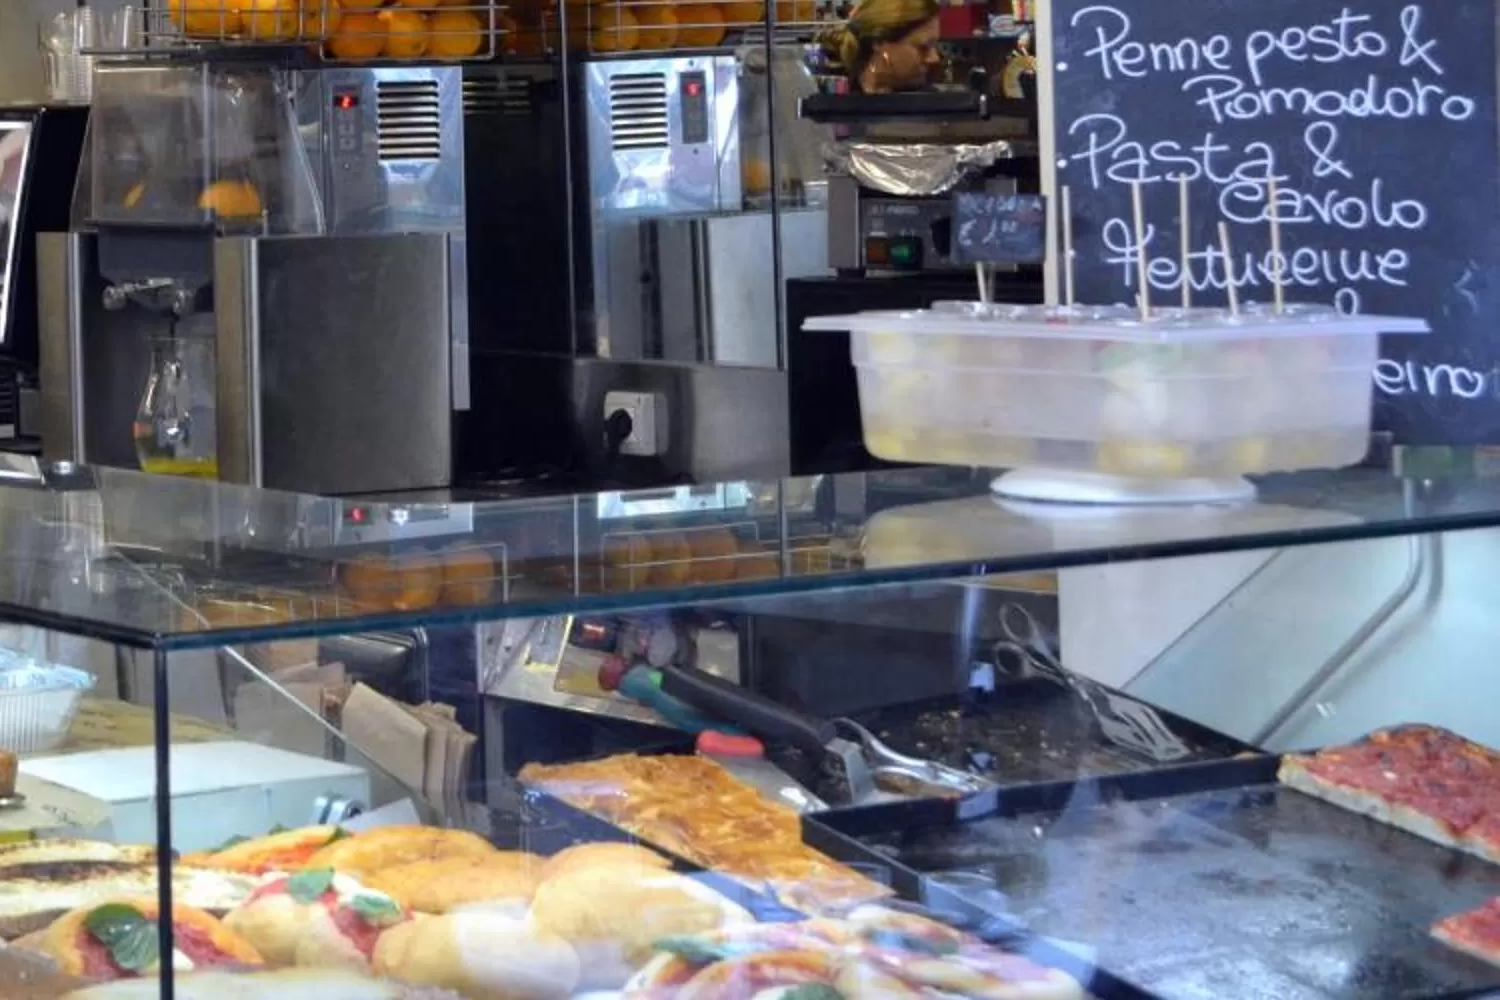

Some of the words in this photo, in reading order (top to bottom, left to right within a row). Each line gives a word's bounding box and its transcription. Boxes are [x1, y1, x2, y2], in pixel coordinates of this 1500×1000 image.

[1070, 5, 1232, 80] Penne
[1246, 8, 1387, 86] pesto
[1399, 4, 1444, 75] &
[1182, 73, 1476, 124] Pomodoro
[1068, 113, 1290, 189] Pasta
[1303, 120, 1354, 179] &
